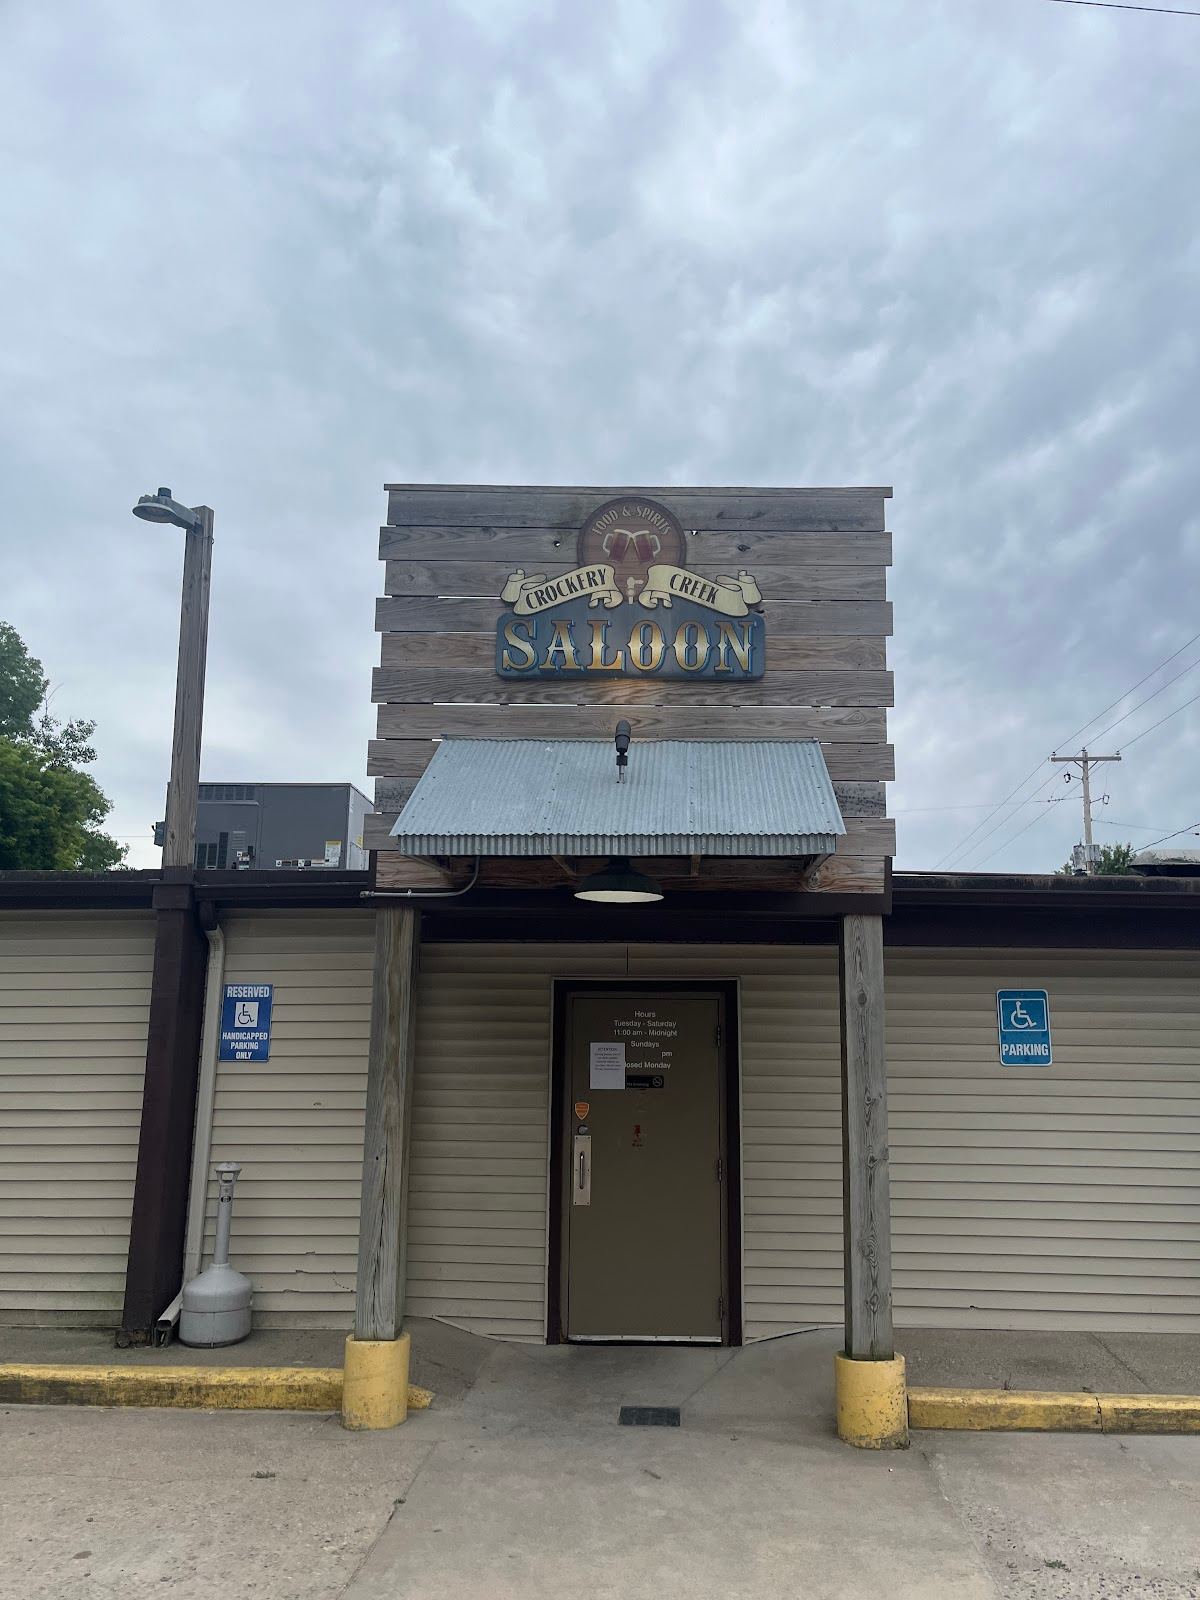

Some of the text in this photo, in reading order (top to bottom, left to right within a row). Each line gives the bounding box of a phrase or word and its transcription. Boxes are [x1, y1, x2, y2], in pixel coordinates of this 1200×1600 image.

[592, 505, 673, 536] FOOD & SPIRITS
[525, 568, 719, 610] CROCKERY CREEK
[502, 618, 759, 673] SALOON
[226, 986, 270, 998] RESERVED
[634, 1010, 656, 1018] Hours
[614, 1020, 642, 1028] Tuesday
[647, 1020, 677, 1029] Saturday
[222, 1032, 268, 1040] HANDICAPPED
[648, 1029, 678, 1037] Midnight
[230, 1041, 259, 1050] PARKING
[630, 1040, 660, 1049] Sundays
[1002, 1043, 1049, 1056] PARKING
[235, 1051, 253, 1060] ONLY
[661, 1051, 673, 1059] pm
[644, 1061, 671, 1070] Monday
